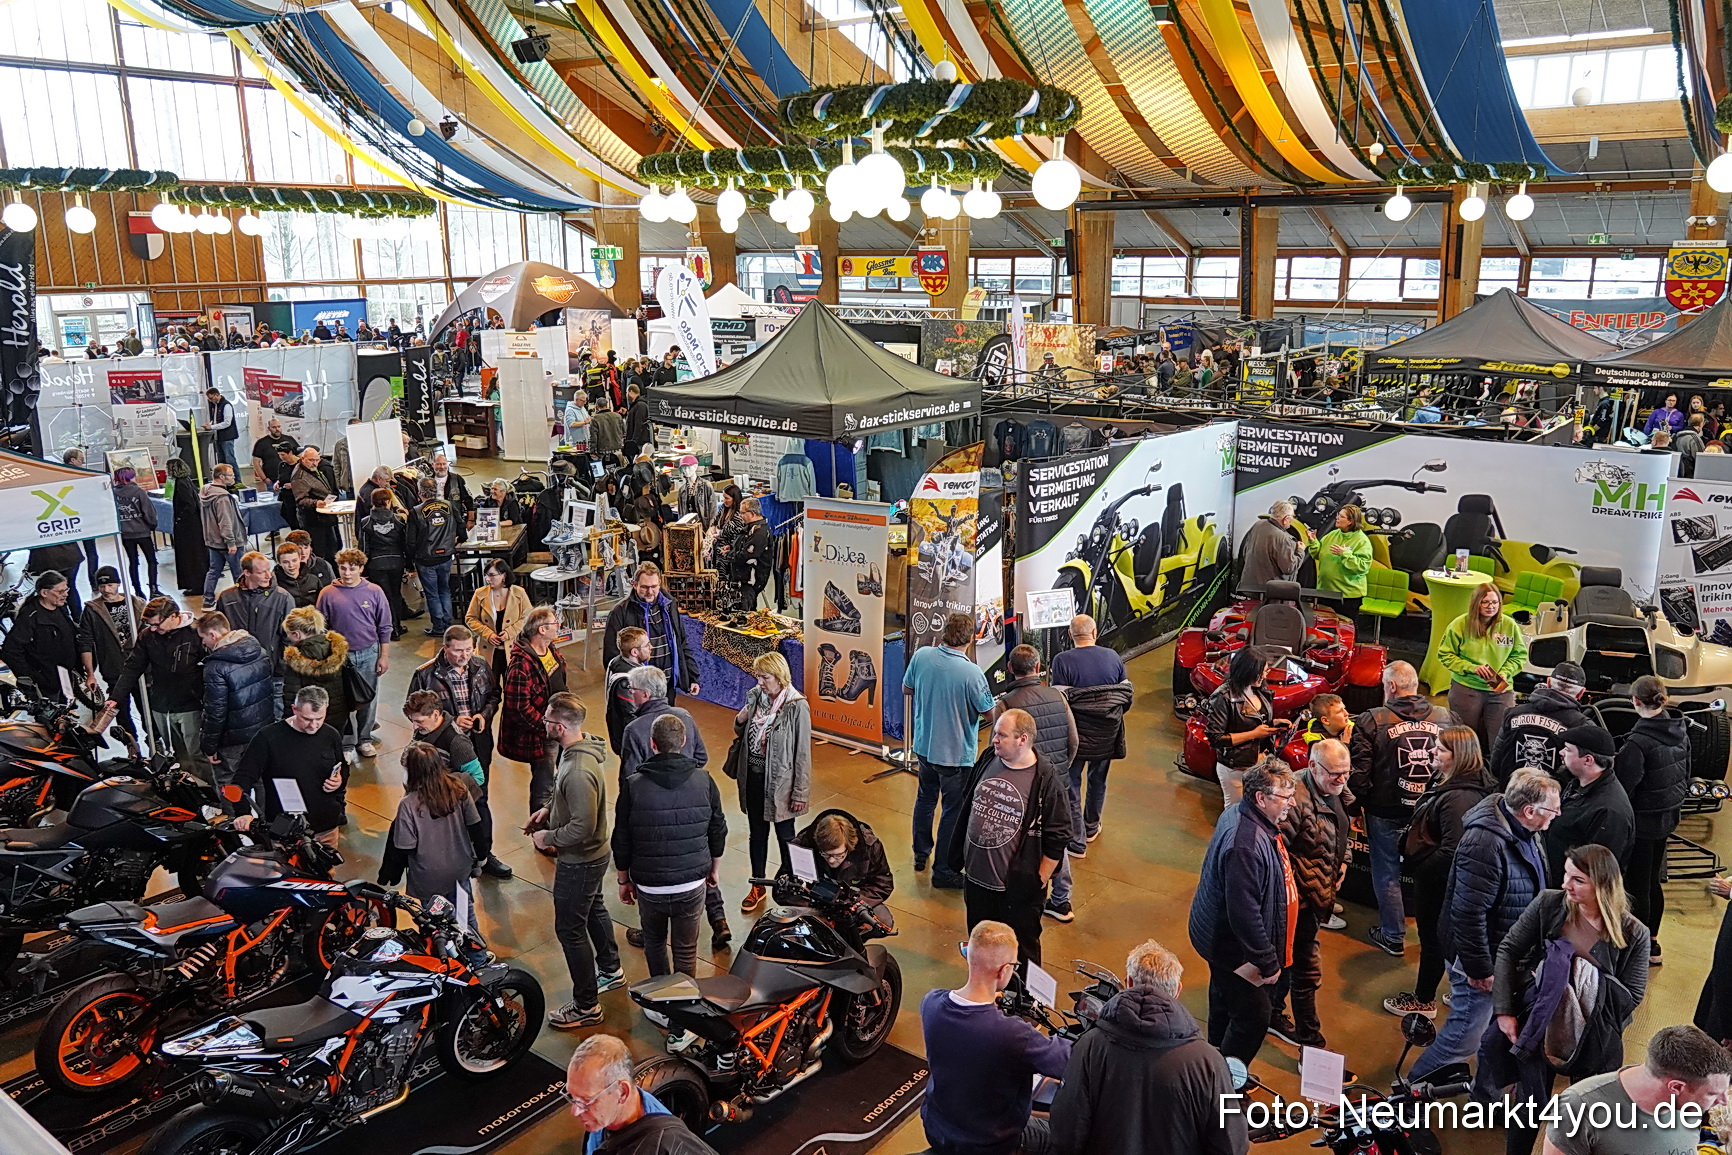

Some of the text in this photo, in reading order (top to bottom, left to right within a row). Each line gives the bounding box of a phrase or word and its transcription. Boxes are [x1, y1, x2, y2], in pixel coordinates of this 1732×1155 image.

[866, 258, 896, 276] Glossner
[883, 268, 897, 276] Bier
[0, 263, 30, 350] Herold
[764, 324, 785, 332] ro-r
[1570, 310, 1667, 331] ENFIELD
[1595, 368, 1650, 377] Deutschlands
[1607, 377, 1670, 386] Zweirad-Center
[413, 359, 430, 426] Herold
[675, 406, 798, 432] dax-stickservice.de
[860, 400, 960, 428] dax-stickservice.de
[1029, 454, 1108, 482] SERVICESTATION
[1028, 473, 1095, 498] VERMIETUNG
[1028, 493, 1079, 514] VERKAUF
[1593, 480, 1666, 510] MH
[38, 517, 80, 533] GRIP
[978, 515, 990, 530] UNG
[1029, 514, 1058, 524] FÜR TRIKES
[976, 520, 998, 545] STATION
[976, 544, 986, 558] KES
[946, 600, 972, 613] triking
[1399, 722, 1434, 732] TRUST
[1520, 716, 1536, 724] IRON
[1539, 717, 1557, 729] FIST
[1399, 780, 1423, 791] GERM
[988, 808, 1020, 824] CULTURE
[863, 1068, 928, 1123] motoroox.de
[478, 1080, 565, 1136] motoroox.de
